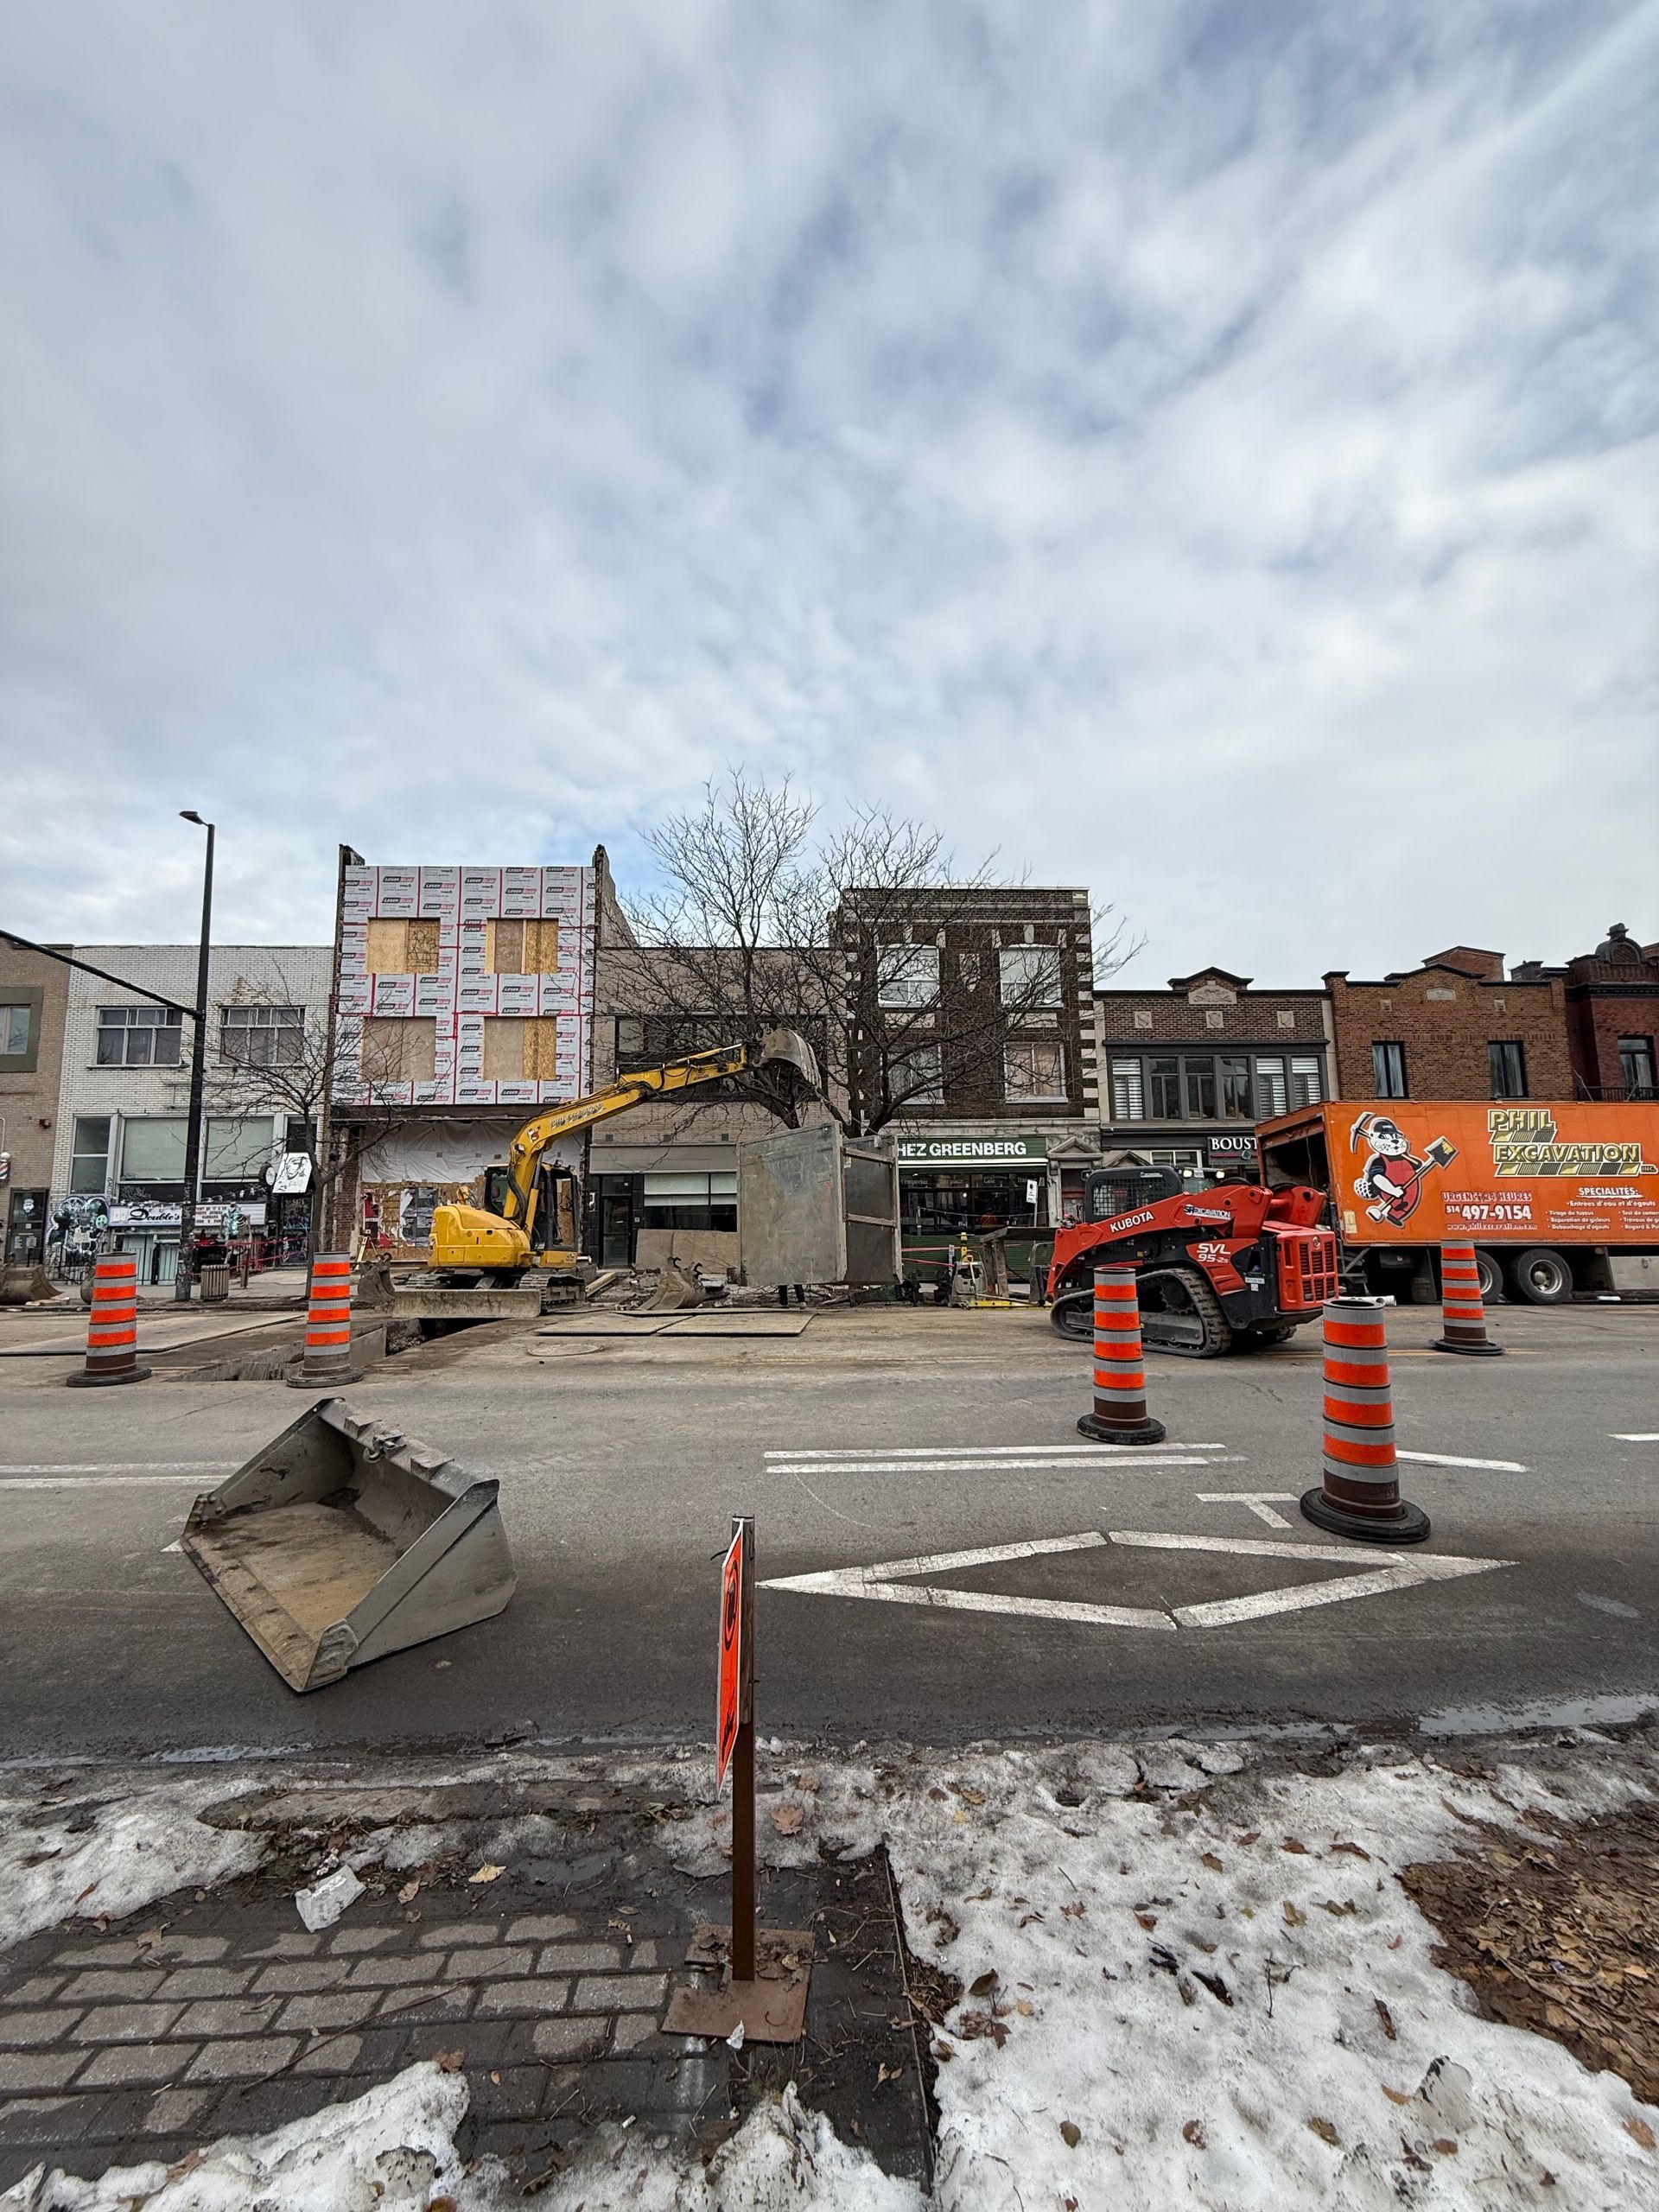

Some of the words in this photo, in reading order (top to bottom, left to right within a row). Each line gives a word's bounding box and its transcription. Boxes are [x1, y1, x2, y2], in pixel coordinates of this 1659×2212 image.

[1490, 1110, 1554, 1130] PHIL
[929, 1141, 1027, 1156] GREENBERG
[1211, 1137, 1258, 1150] BOUST
[1495, 1144, 1640, 1163] EXCAVATION
[1498, 1192, 1533, 1202] HEURES
[127, 1208, 180, 1221] Double's
[1446, 1205, 1460, 1214] 514
[1462, 1205, 1532, 1220] 497-9154
[1109, 1211, 1154, 1234] KUBOTA
[1197, 1243, 1230, 1255] SVL
